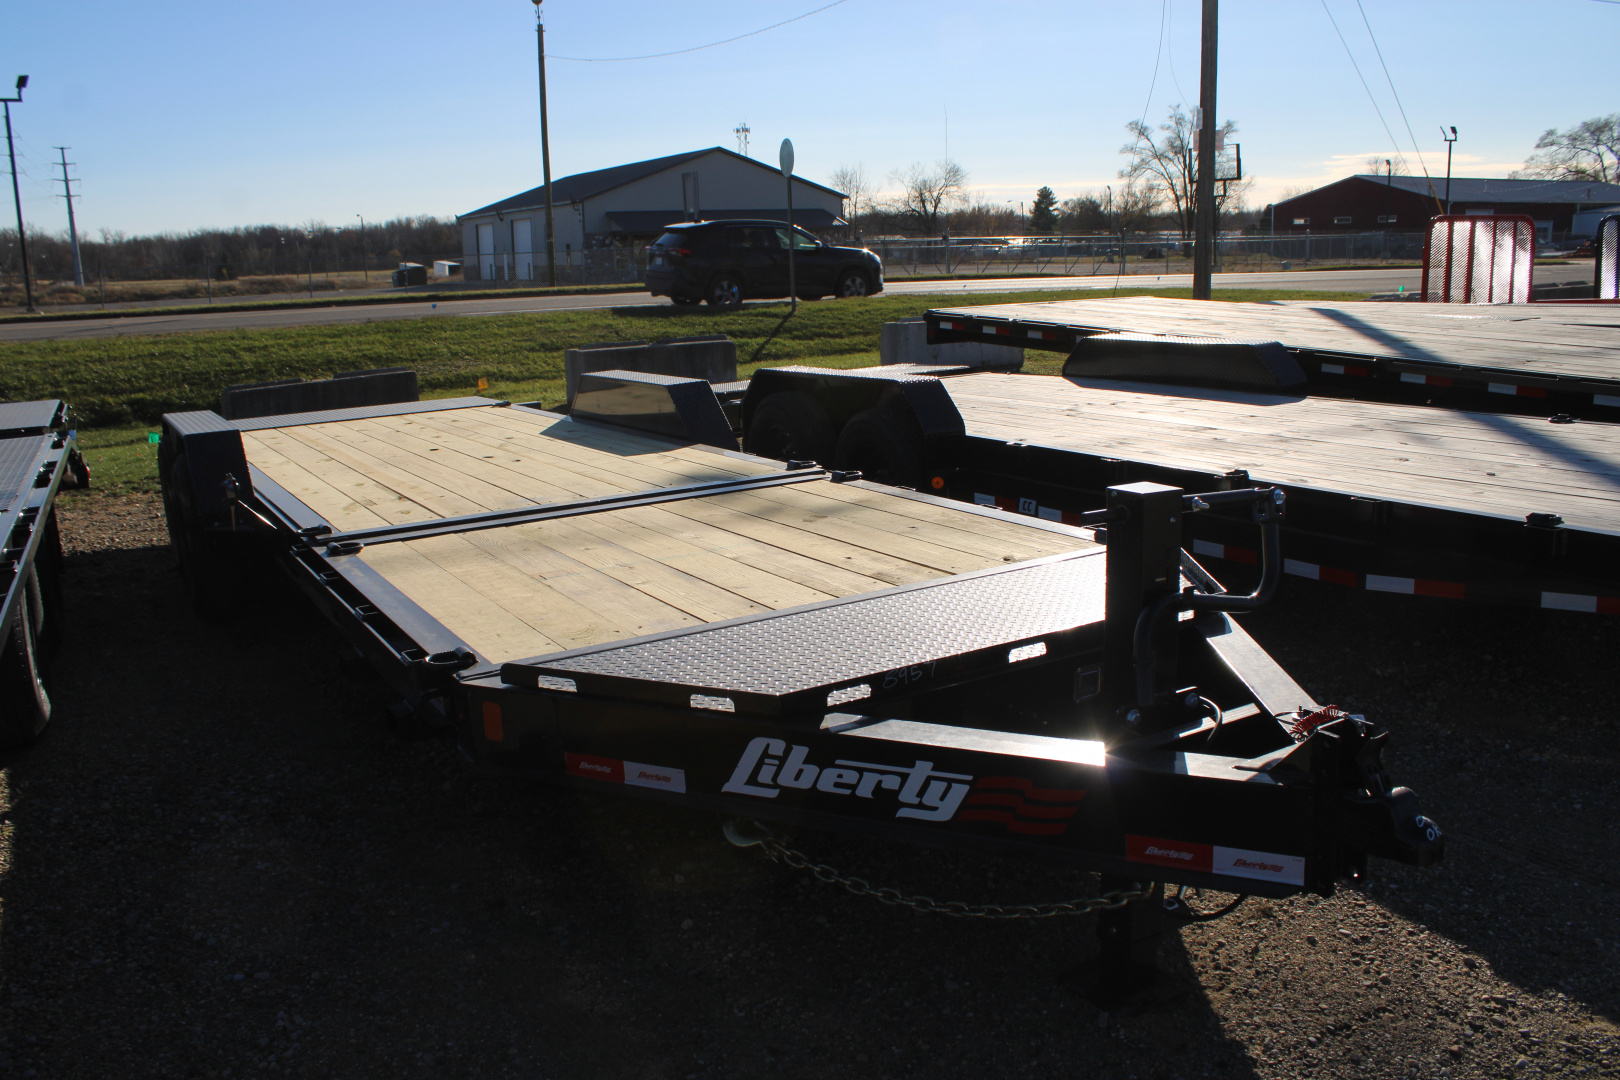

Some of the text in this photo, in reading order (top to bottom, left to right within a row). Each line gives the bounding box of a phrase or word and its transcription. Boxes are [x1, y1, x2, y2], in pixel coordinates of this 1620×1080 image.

[882, 660, 937, 688] 8957
[721, 737, 973, 822] Liberty
[1144, 846, 1181, 859] Liberty
[1232, 858, 1269, 870] Liberty
